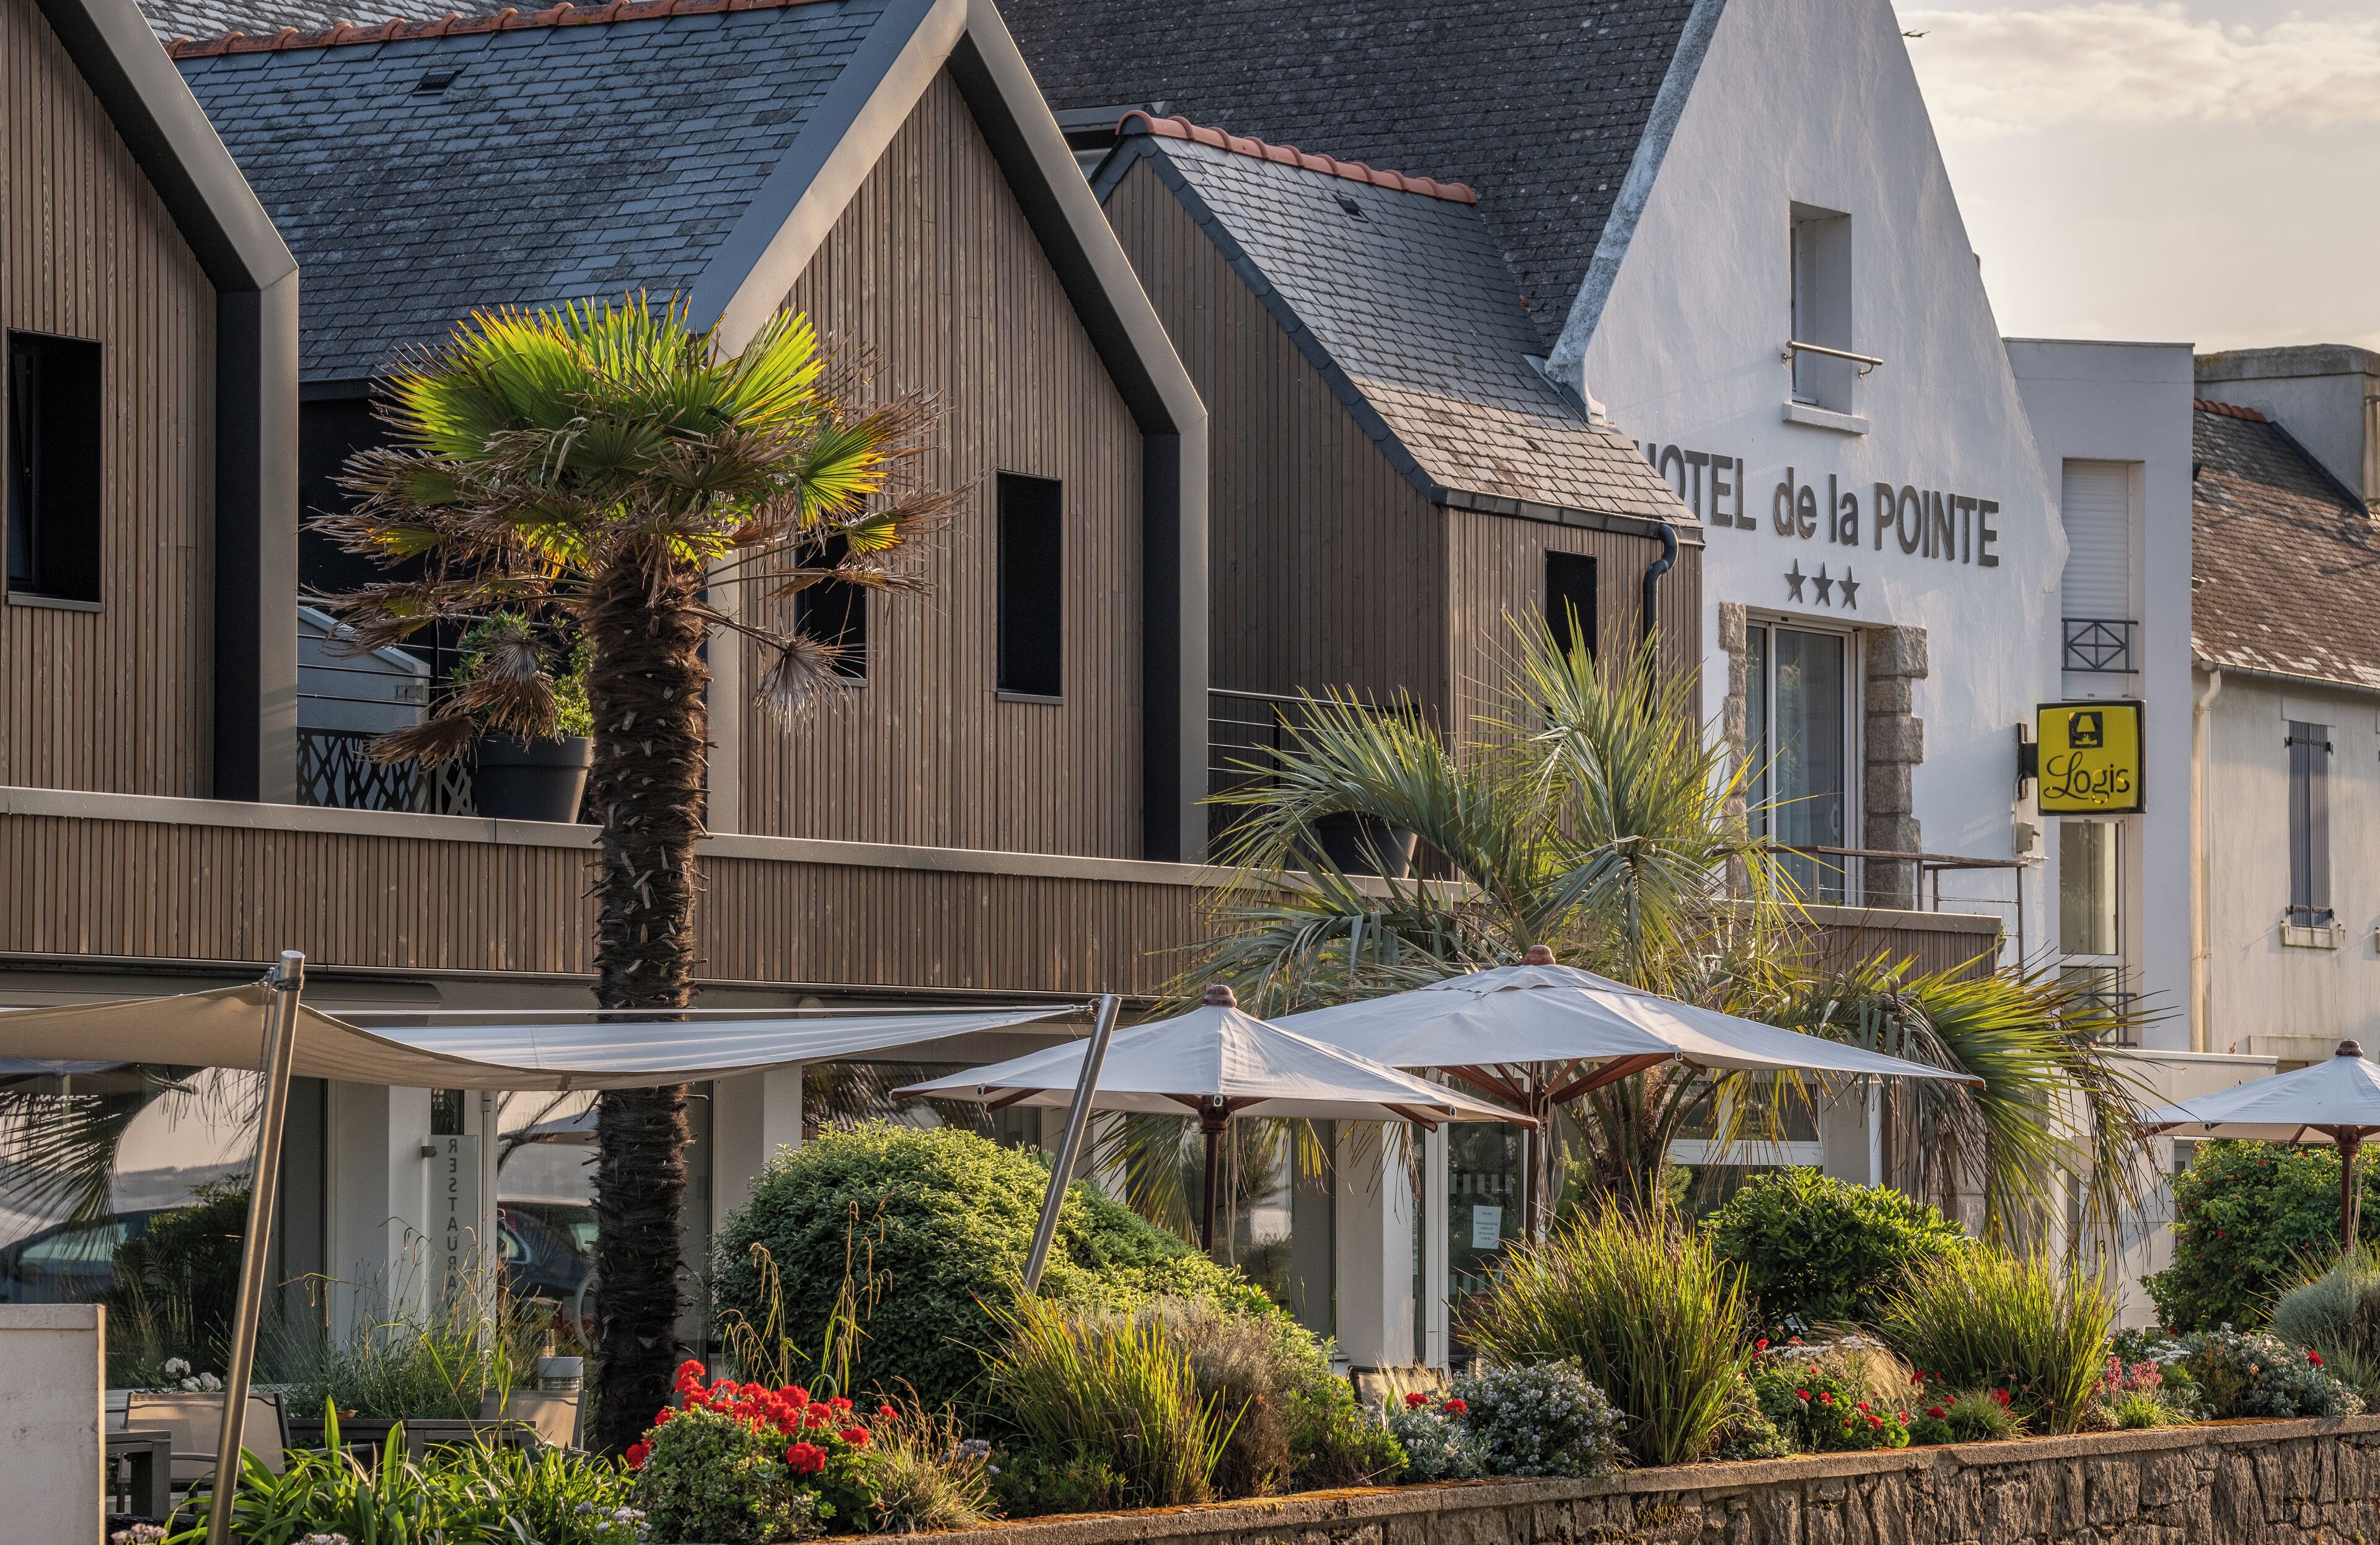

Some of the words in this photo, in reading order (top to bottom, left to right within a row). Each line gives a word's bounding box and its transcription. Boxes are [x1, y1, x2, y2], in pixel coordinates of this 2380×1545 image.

[1632, 440, 1756, 531] OTEL
[1773, 466, 1817, 539] de
[1829, 473, 1859, 546] la
[1874, 482, 1999, 567] POINTE
[2043, 751, 2130, 804] Logis
